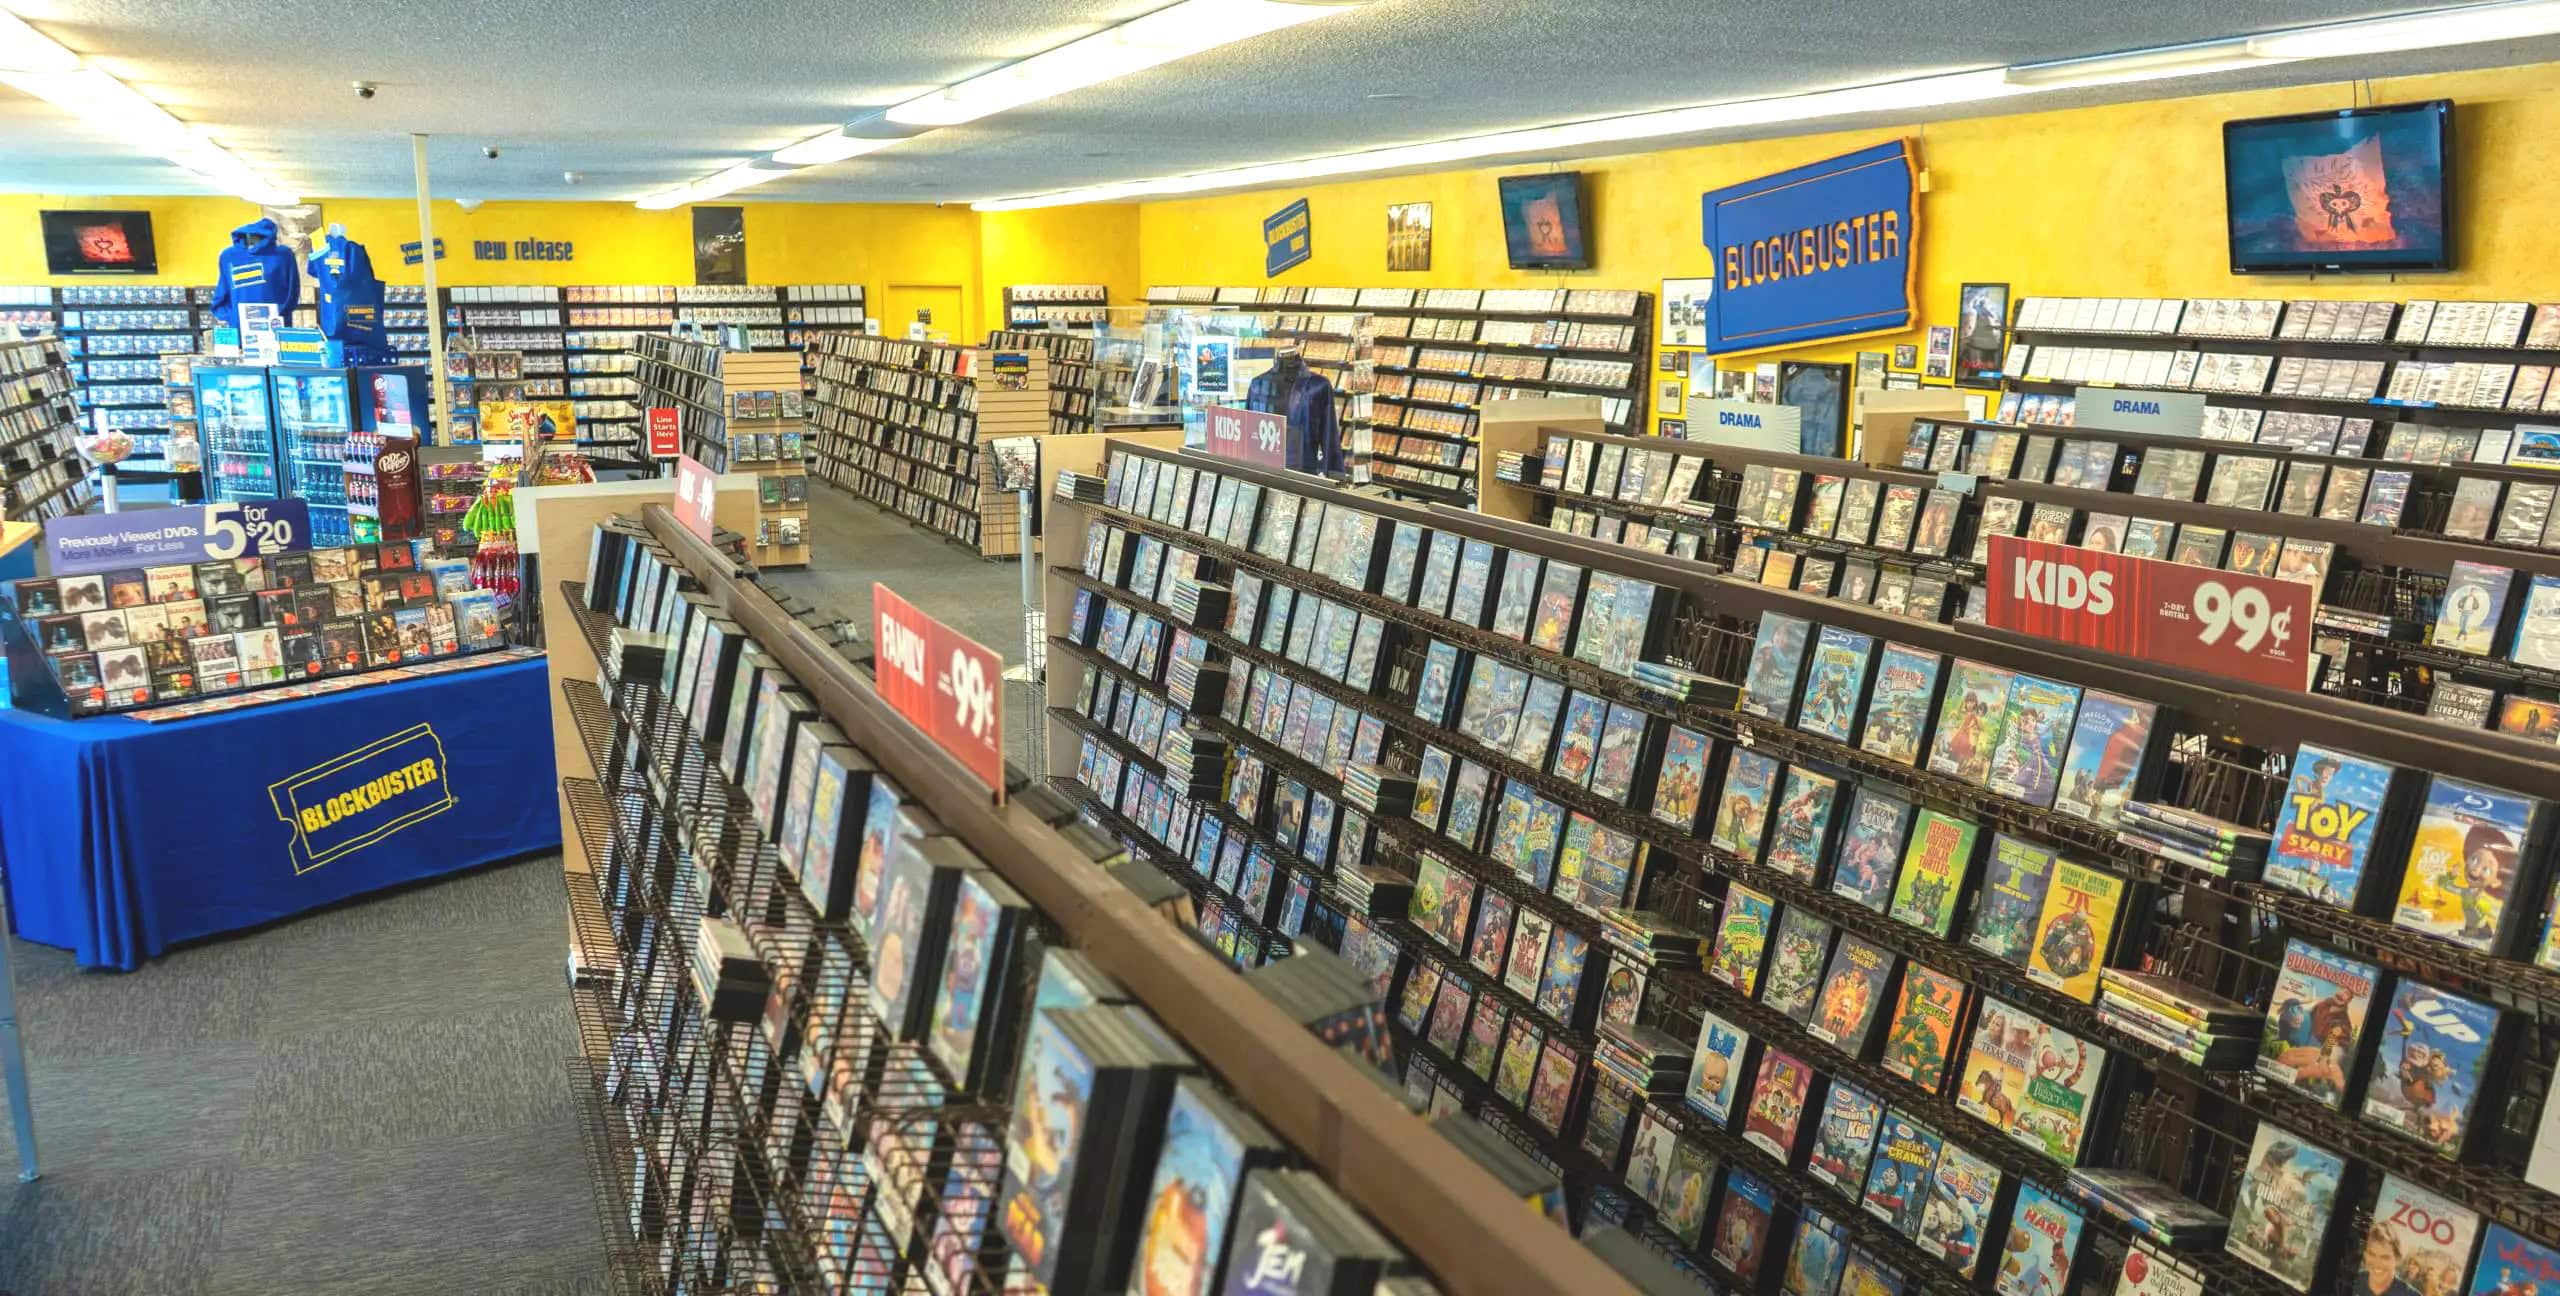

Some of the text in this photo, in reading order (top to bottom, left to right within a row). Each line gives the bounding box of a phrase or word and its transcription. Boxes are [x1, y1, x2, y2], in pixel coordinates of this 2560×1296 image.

[474, 237, 573, 261] new release
[1724, 209, 1899, 290] BLOCKBUSTER
[1719, 411, 1762, 430] DRAMA
[2113, 399, 2161, 416] DRAMA
[1215, 415, 1241, 441] KIDS
[59, 526, 198, 549] Previously Viewed DVDs
[203, 502, 266, 560] 5 for
[246, 519, 292, 546] $20
[61, 547, 92, 560] More
[136, 543, 155, 553] For
[157, 541, 184, 551] Less
[2014, 556, 2114, 616] KIDS
[2193, 580, 2292, 653] 99¢
[881, 612, 926, 687] FAMILY
[2438, 690, 2458, 702] FILM
[2433, 703, 2479, 721] LIVERPOOL
[301, 757, 438, 833] BLOCKBUSTER
[2291, 793, 2369, 842] TOY
[2288, 833, 2347, 860] STORY
[2288, 952, 2332, 979] BUNYAN
[2340, 975, 2370, 997] BABE
[2409, 1000, 2481, 1043] UP
[1981, 1041, 2005, 1059] TEXAS
[1888, 1145, 1933, 1168] CRANKY
[2024, 1208, 2066, 1237] HARE
[2390, 1199, 2455, 1246] ZOO
[1245, 1227, 1306, 1289] JEM
